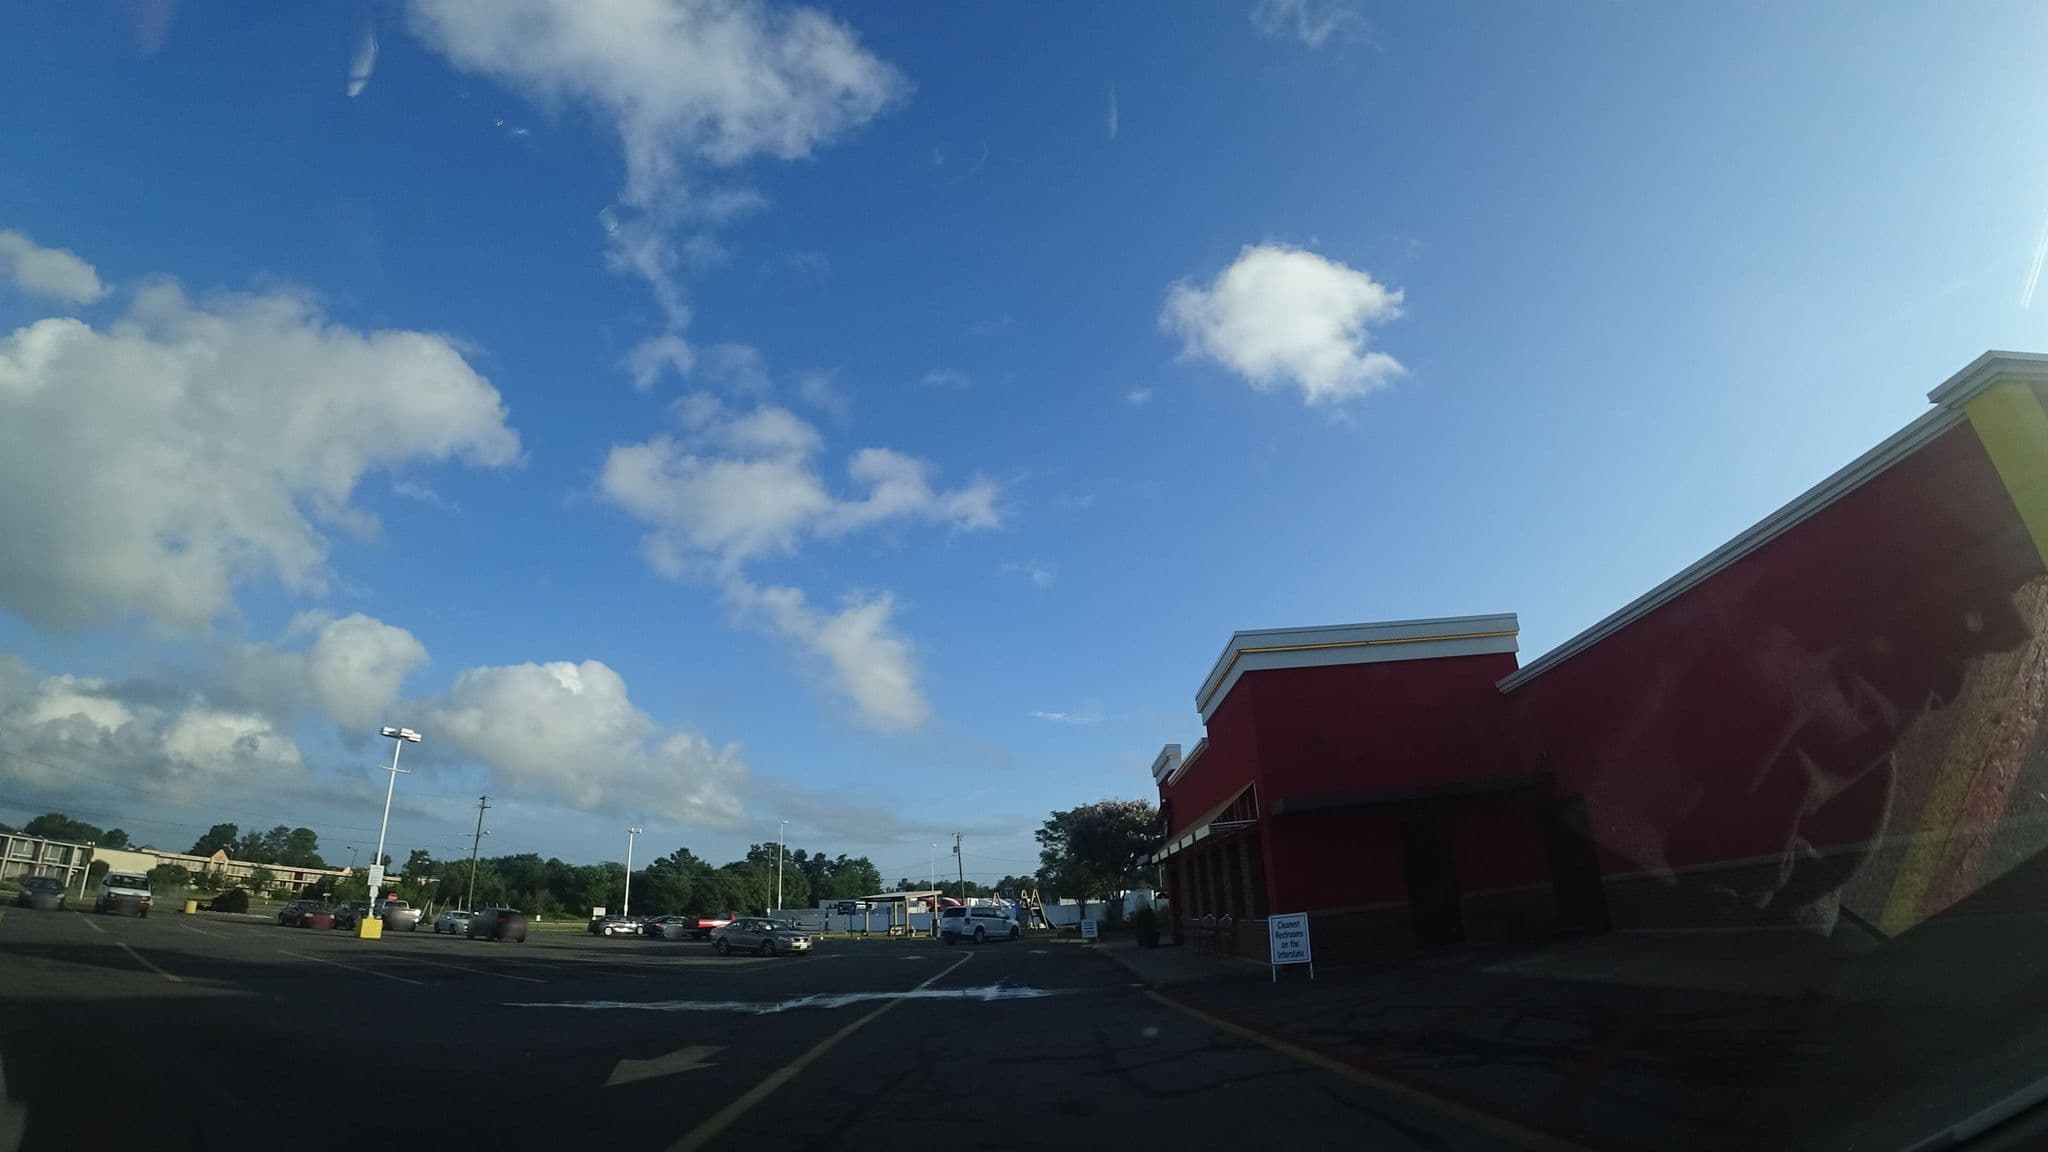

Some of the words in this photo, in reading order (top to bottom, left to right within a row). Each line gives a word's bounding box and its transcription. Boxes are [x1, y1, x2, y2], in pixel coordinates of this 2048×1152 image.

[1277, 920, 1300, 929] Cleanest
[1275, 931, 1304, 939] Restrooms
[1290, 940, 1300, 948] the
